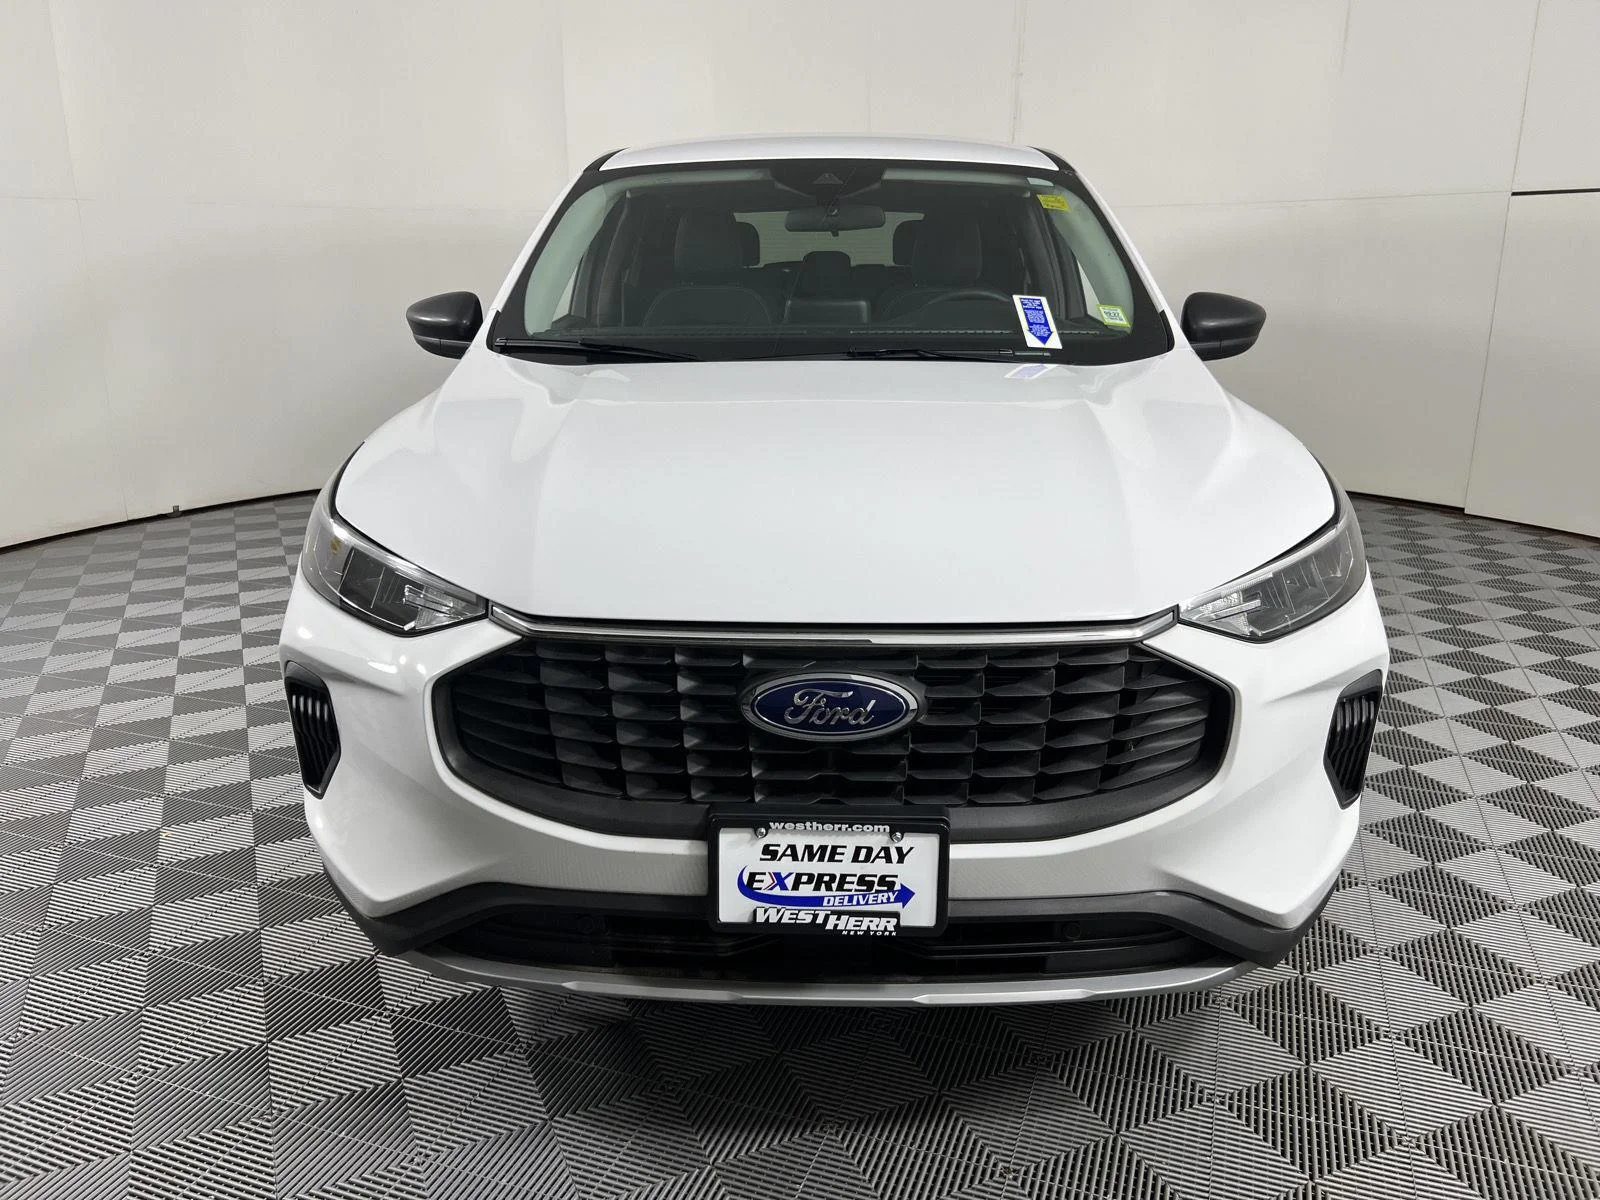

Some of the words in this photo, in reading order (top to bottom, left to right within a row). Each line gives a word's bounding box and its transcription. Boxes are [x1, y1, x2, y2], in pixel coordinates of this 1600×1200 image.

[784, 688, 876, 725] Ford
[769, 821, 890, 833] westherr.com
[760, 843, 847, 863] SAME
[851, 846, 914, 864] DAY
[746, 871, 898, 892] EXPRESS
[823, 891, 898, 907] DELIVERY
